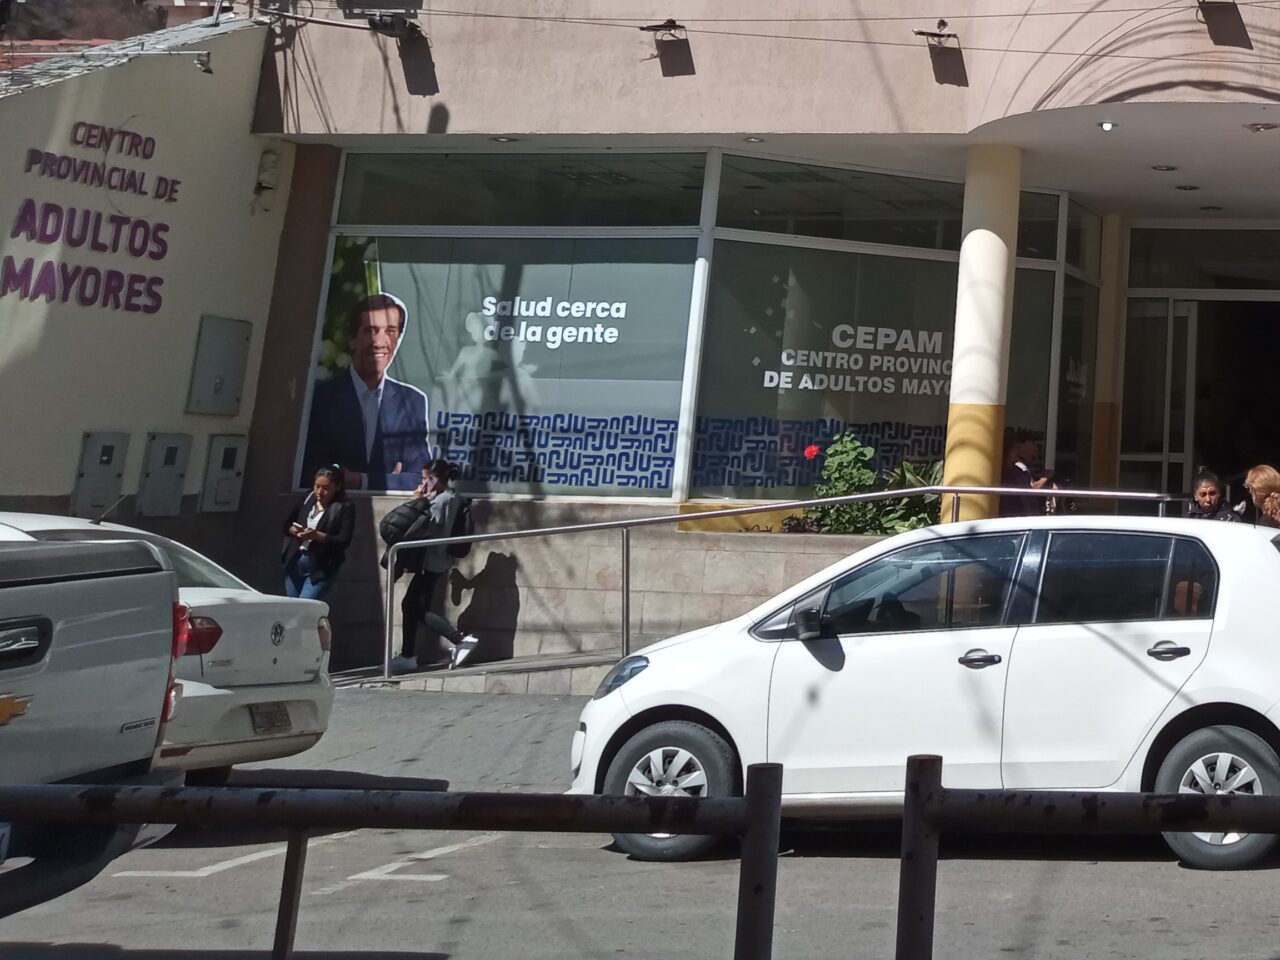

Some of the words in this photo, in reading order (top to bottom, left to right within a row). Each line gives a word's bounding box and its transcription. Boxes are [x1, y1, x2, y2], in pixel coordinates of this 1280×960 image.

[71, 121, 156, 159] CENTRO
[24, 148, 148, 196] PROVINCIAL
[152, 176, 182, 203] DE
[10, 198, 169, 260] ADULTOS
[0, 255, 164, 314] MAYORES
[482, 297, 552, 318] Salud
[556, 301, 627, 318] cerca
[484, 321, 515, 341] de
[519, 321, 542, 342] la
[546, 323, 619, 349] gente
[832, 324, 943, 353] CEPAM
[781, 349, 863, 370] CENTRO
[869, 355, 952, 375] PROVINC
[763, 371, 793, 388] DE
[798, 373, 896, 394] ADULTOS
